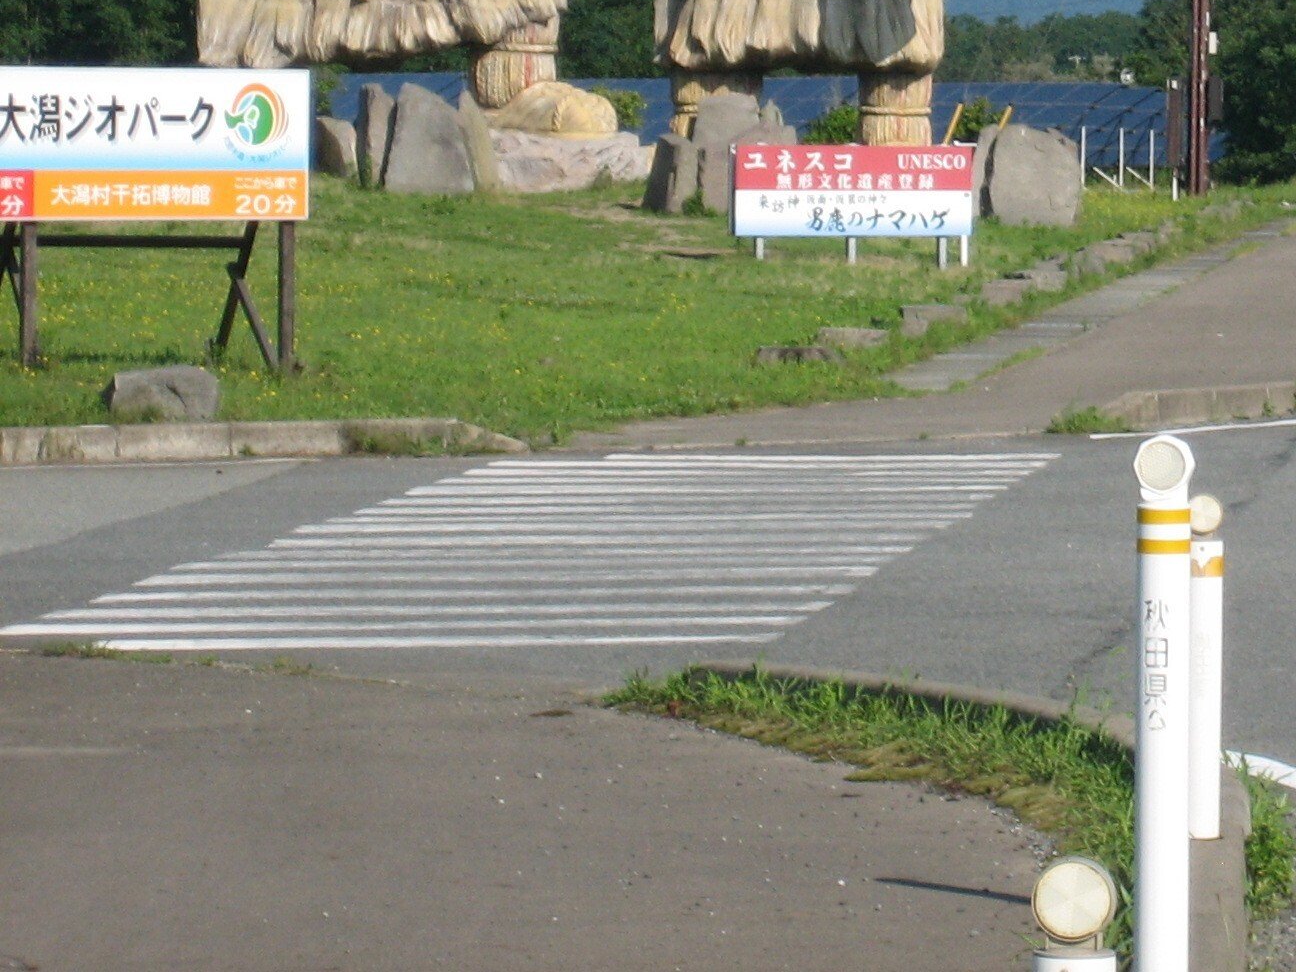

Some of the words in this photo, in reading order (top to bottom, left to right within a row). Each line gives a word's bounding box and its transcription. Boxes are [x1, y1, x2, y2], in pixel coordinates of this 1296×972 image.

[743, 149, 853, 173] ユネスコ
[897, 153, 966, 170] UNESCO
[775, 173, 935, 190] 無形文化遺産登録
[50, 184, 212, 206] 大潟村干拓博物館
[235, 194, 297, 215] 20分
